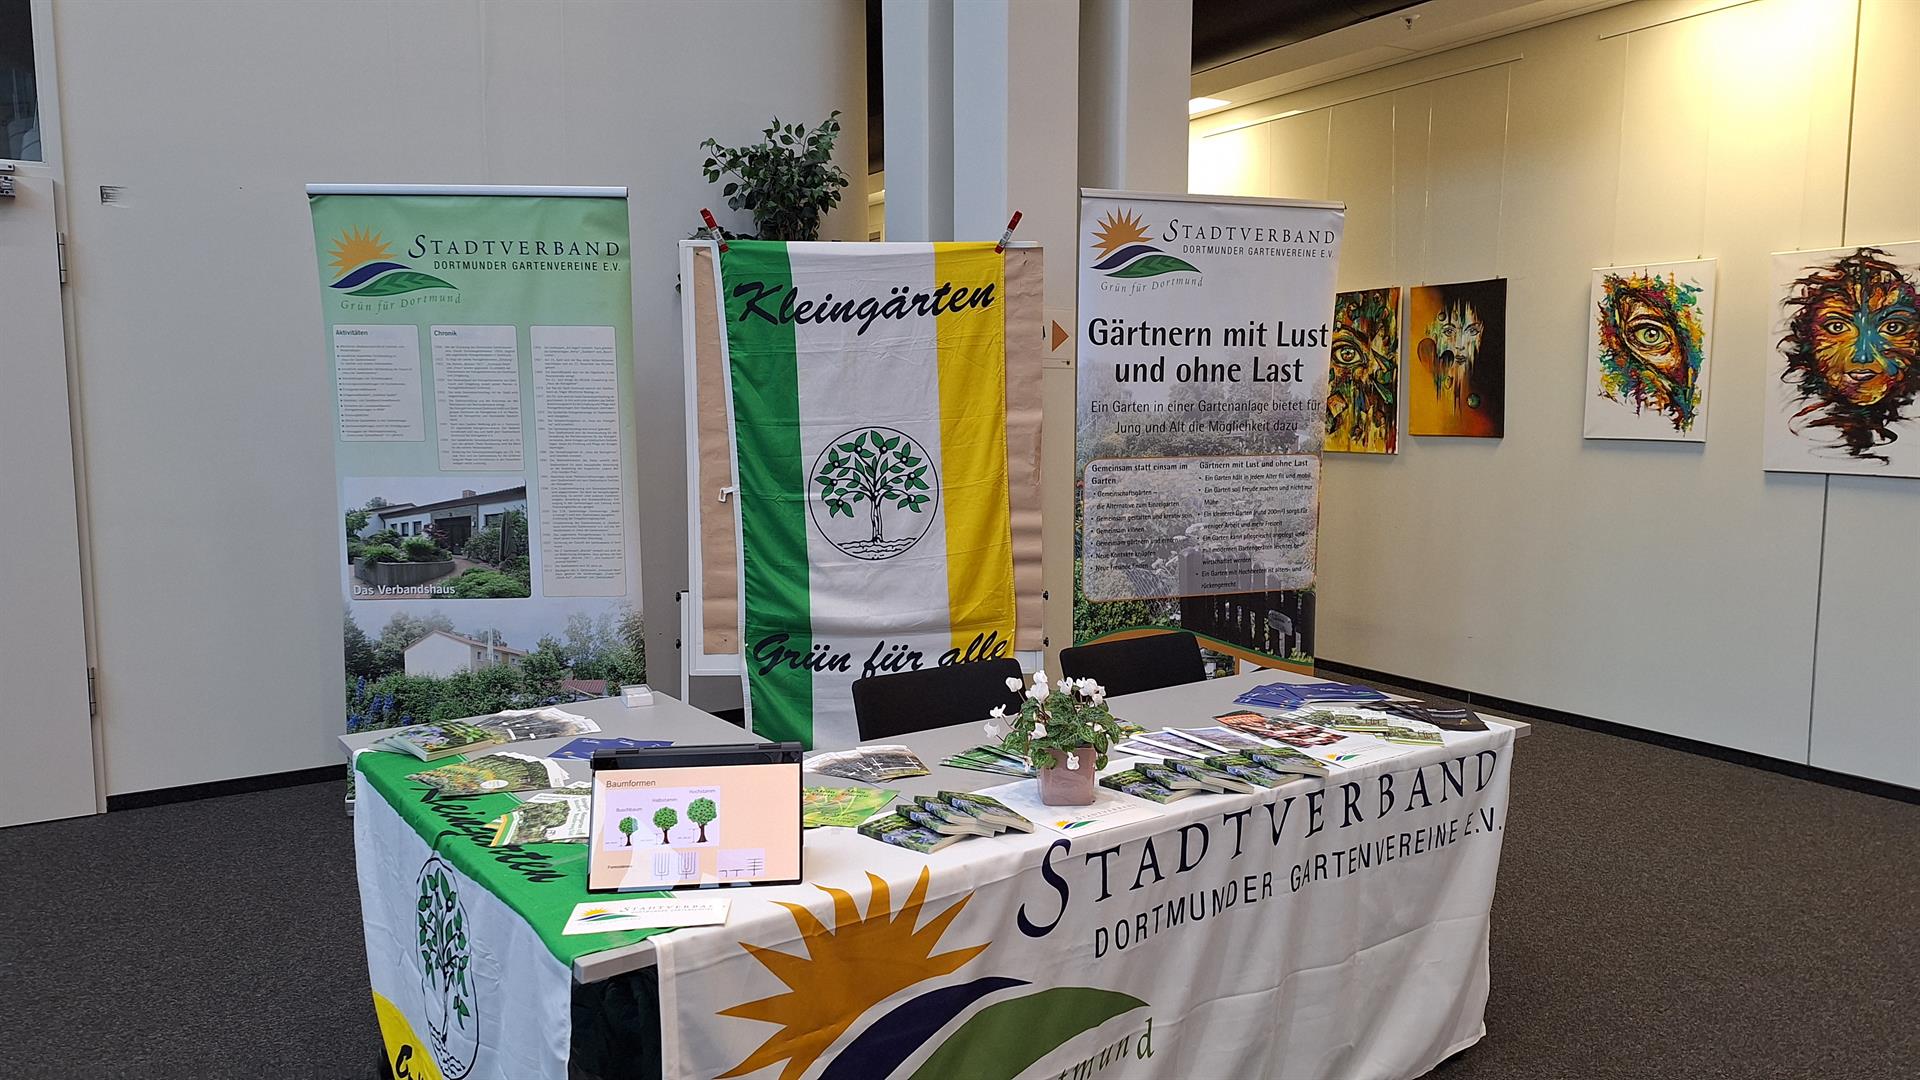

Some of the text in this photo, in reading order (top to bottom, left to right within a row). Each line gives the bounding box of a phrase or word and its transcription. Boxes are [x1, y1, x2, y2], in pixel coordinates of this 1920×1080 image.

[1162, 218, 1335, 244] STADTVERBAND
[408, 234, 620, 259] STADTVERBAND
[1183, 246, 1334, 258] DORTMUNDER GARTENVEREINE E.V.
[434, 260, 621, 272] DORTMUNDER GARTENVEREINE E.V.
[1100, 276, 1204, 296] Grün für Dortmund
[340, 294, 461, 315] Grün für Dortmund
[734, 281, 995, 336] Kleingärten
[1088, 318, 1329, 347] Gärtnern mit Lust
[1115, 356, 1304, 382] und ohne Last
[1091, 400, 1321, 414] Ein Garten in einer Gartenanlage bietet für
[1115, 420, 1298, 436] Jung und Alt die Möglichkeit dazu
[353, 584, 456, 595] Das Verbandshaus
[753, 630, 1008, 679] Grün für alle
[606, 780, 656, 788] Baumformen
[1017, 750, 1498, 938] STADTVERBAND
[1094, 806, 1503, 959] DORTMUNDER GARTENVEREINE E.V.
